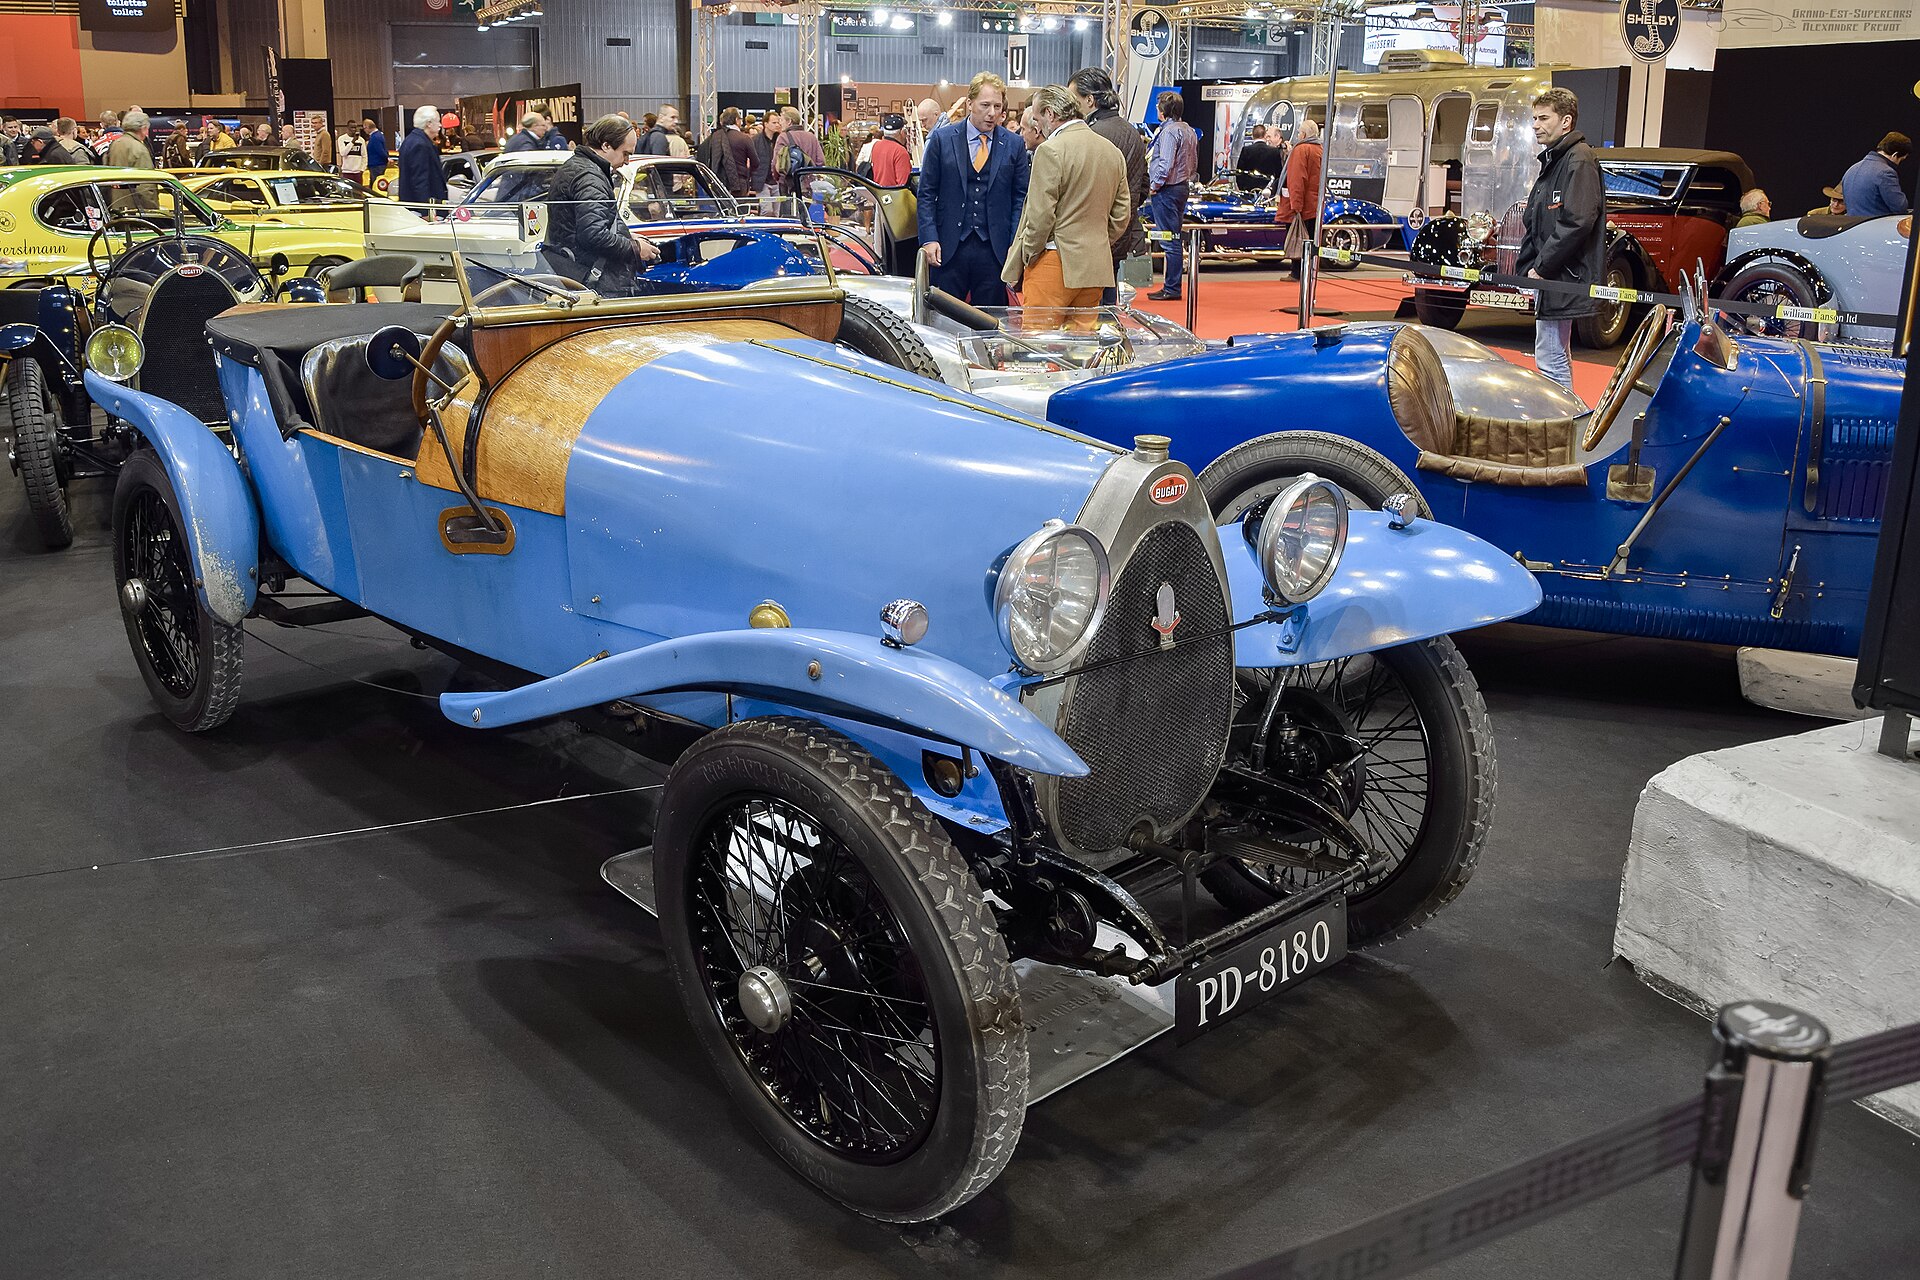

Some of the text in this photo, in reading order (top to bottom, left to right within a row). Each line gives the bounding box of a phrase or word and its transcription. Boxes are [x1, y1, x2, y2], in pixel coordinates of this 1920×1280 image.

[112, 8, 143, 16] toilets
[1627, 13, 1677, 26] SHELBY
[1130, 29, 1168, 39] SHELBY
[1012, 48, 1023, 77] U
[1328, 178, 1352, 189] CAR
[0, 239, 68, 256] erstmann
[1594, 287, 1618, 298] william
[1644, 293, 1654, 302] ltd
[1782, 308, 1812, 319] william
[1845, 313, 1858, 324] ltd
[1155, 484, 1186, 499] BUGATTI
[1195, 920, 1330, 1027] PD-8180
